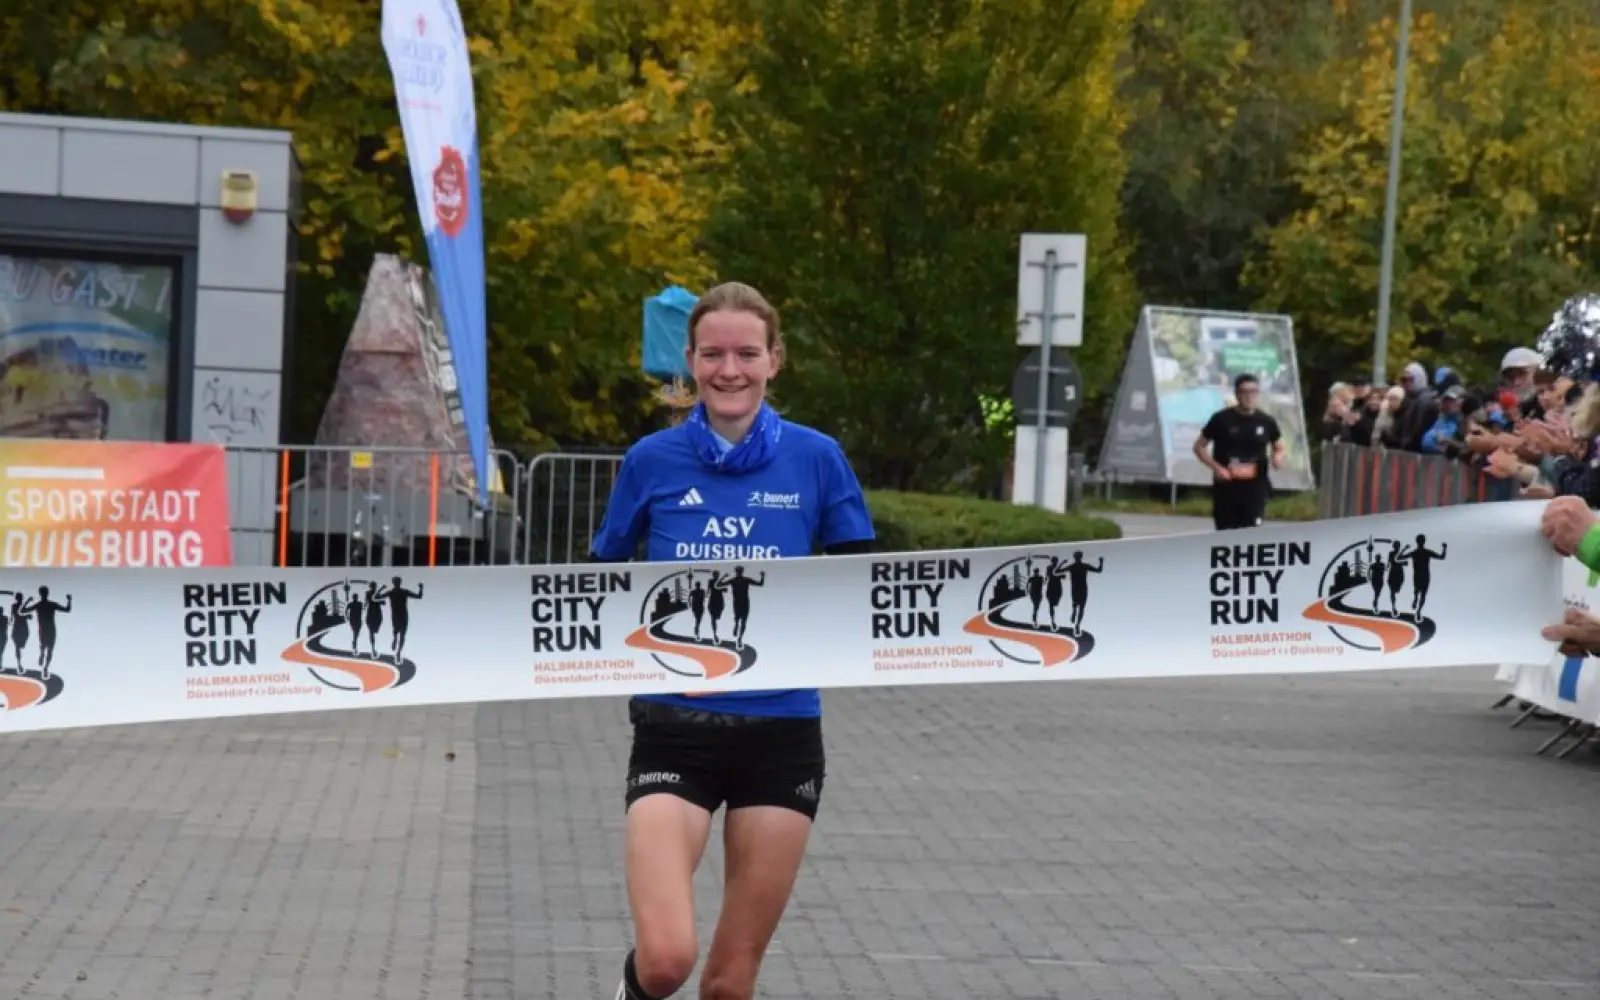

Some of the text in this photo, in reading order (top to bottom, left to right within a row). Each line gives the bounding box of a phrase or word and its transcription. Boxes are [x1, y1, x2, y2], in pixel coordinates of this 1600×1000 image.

[52, 266, 144, 312] GAST
[7, 488, 200, 522] SPORTSTADT
[703, 516, 756, 538] ASV
[4, 529, 203, 567] DUISBURG
[675, 542, 780, 560] DUISBURG
[1210, 541, 1311, 568] RHEIN
[531, 571, 631, 595] RHEIN
[871, 558, 970, 582] RHEIN
[1209, 569, 1284, 597] CITY
[183, 581, 286, 608] RHEIN
[871, 583, 944, 610] CITY
[184, 609, 260, 637] CITY
[532, 596, 606, 623] CITY
[1210, 598, 1279, 625] RUN
[872, 611, 940, 638] RUN
[1211, 631, 1312, 645] HALBMARATHON
[533, 625, 602, 652] RUN
[873, 645, 973, 658] HALBMARATHON
[185, 639, 257, 667] RUN
[534, 659, 634, 672] HALBMARATHON
[186, 673, 290, 687] HALBMARATHON
